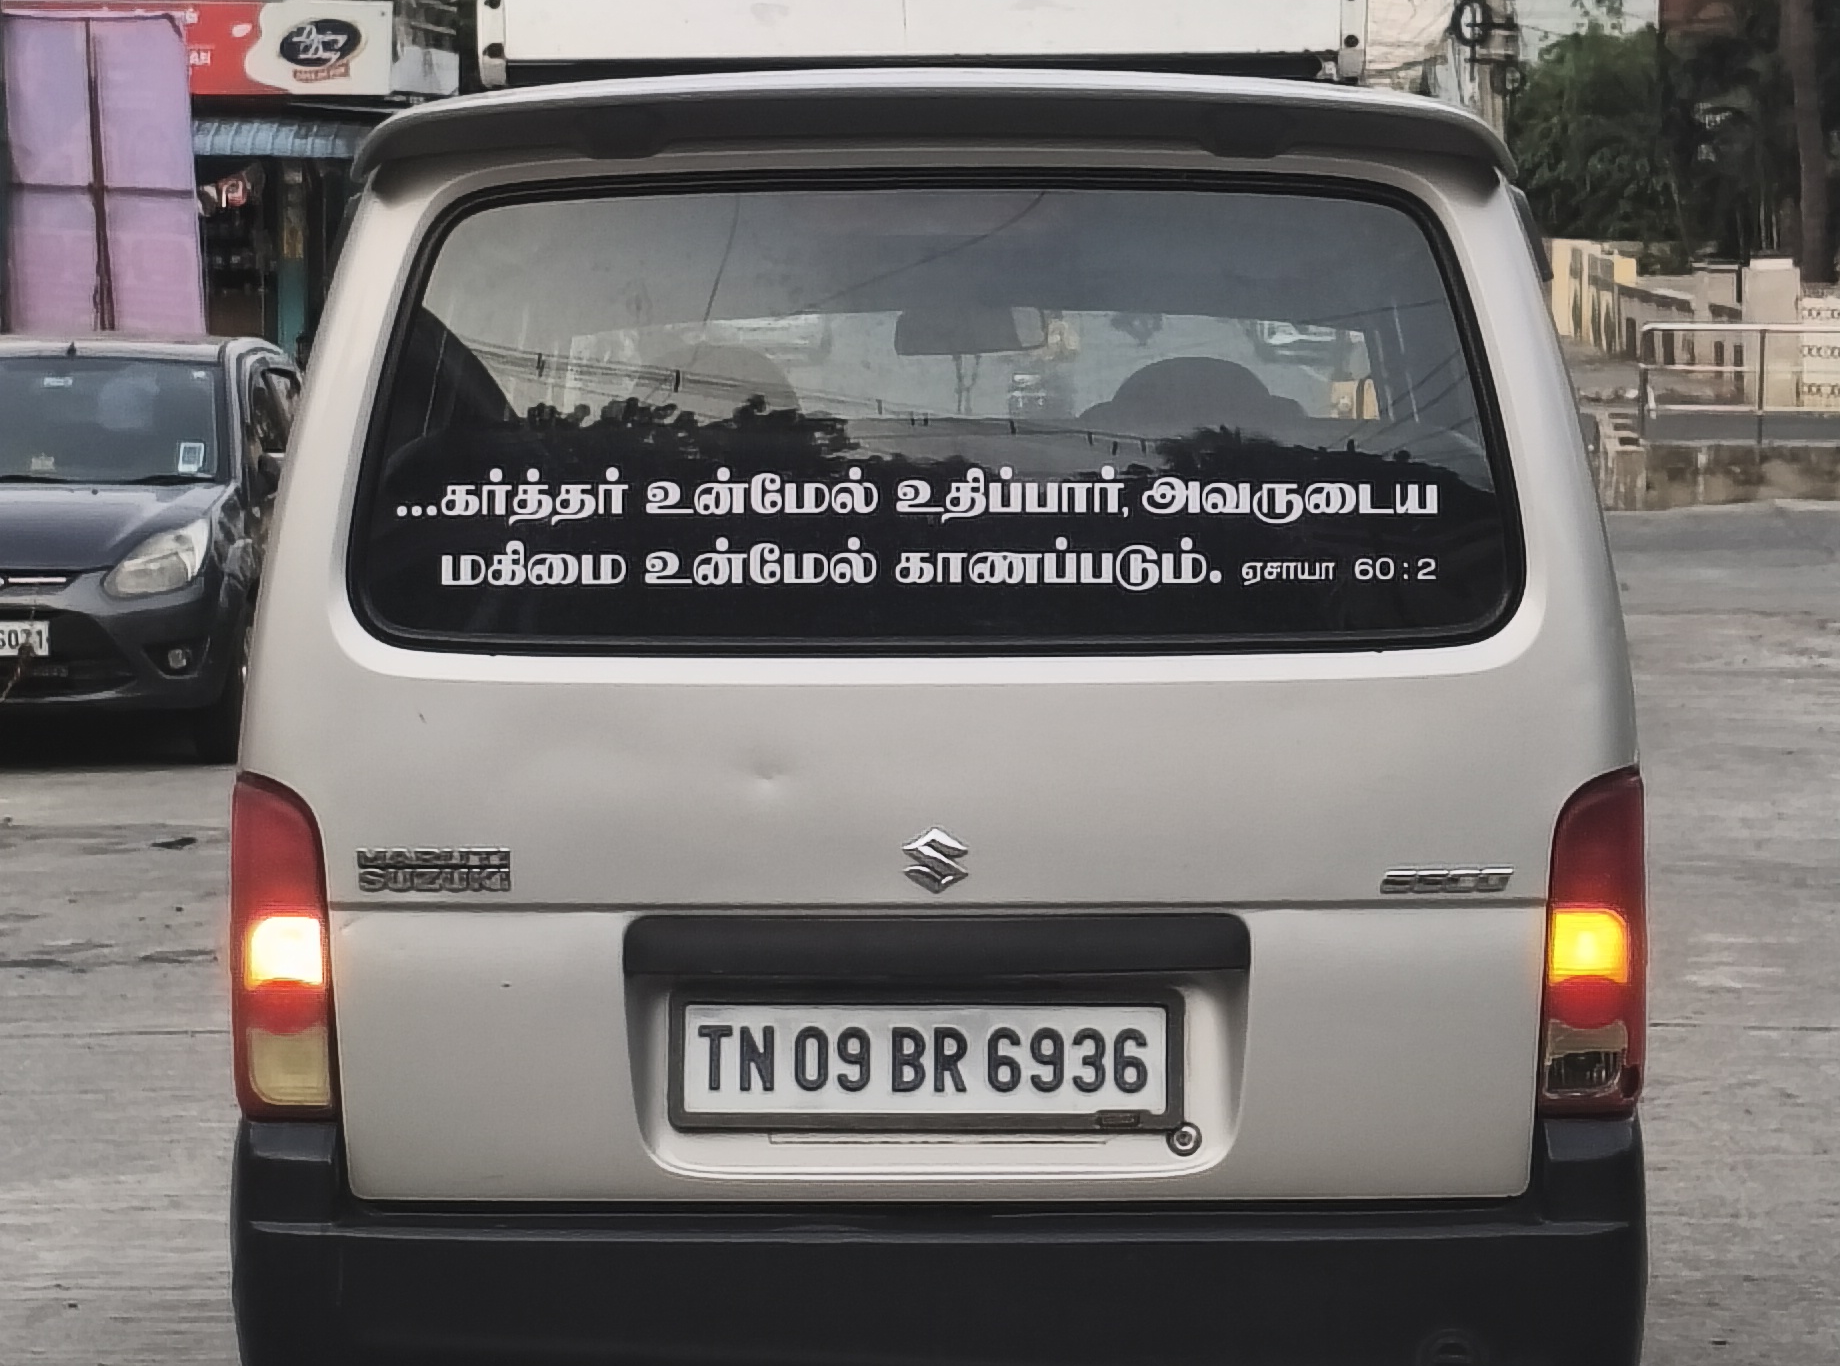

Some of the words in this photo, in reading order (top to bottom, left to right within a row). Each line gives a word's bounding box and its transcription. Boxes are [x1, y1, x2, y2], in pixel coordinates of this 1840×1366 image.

[645, 466, 879, 515] உன்மேல்
[895, 465, 1129, 523] உதிப்பார்,
[1141, 476, 1438, 524] அவருடைய
[441, 540, 627, 586] மகிமை
[644, 536, 877, 586] உன்மேல்
[895, 536, 1222, 591] காணப்படும்.
[1241, 561, 1335, 586] ஏசாயா
[356, 847, 511, 870] MARUTI
[358, 868, 511, 893] SUZUKI
[1379, 868, 1514, 894] EECO
[697, 1024, 775, 1092] TN
[794, 1025, 871, 1093] 09
[891, 1026, 968, 1093] BR
[987, 1026, 1148, 1094] 6936
